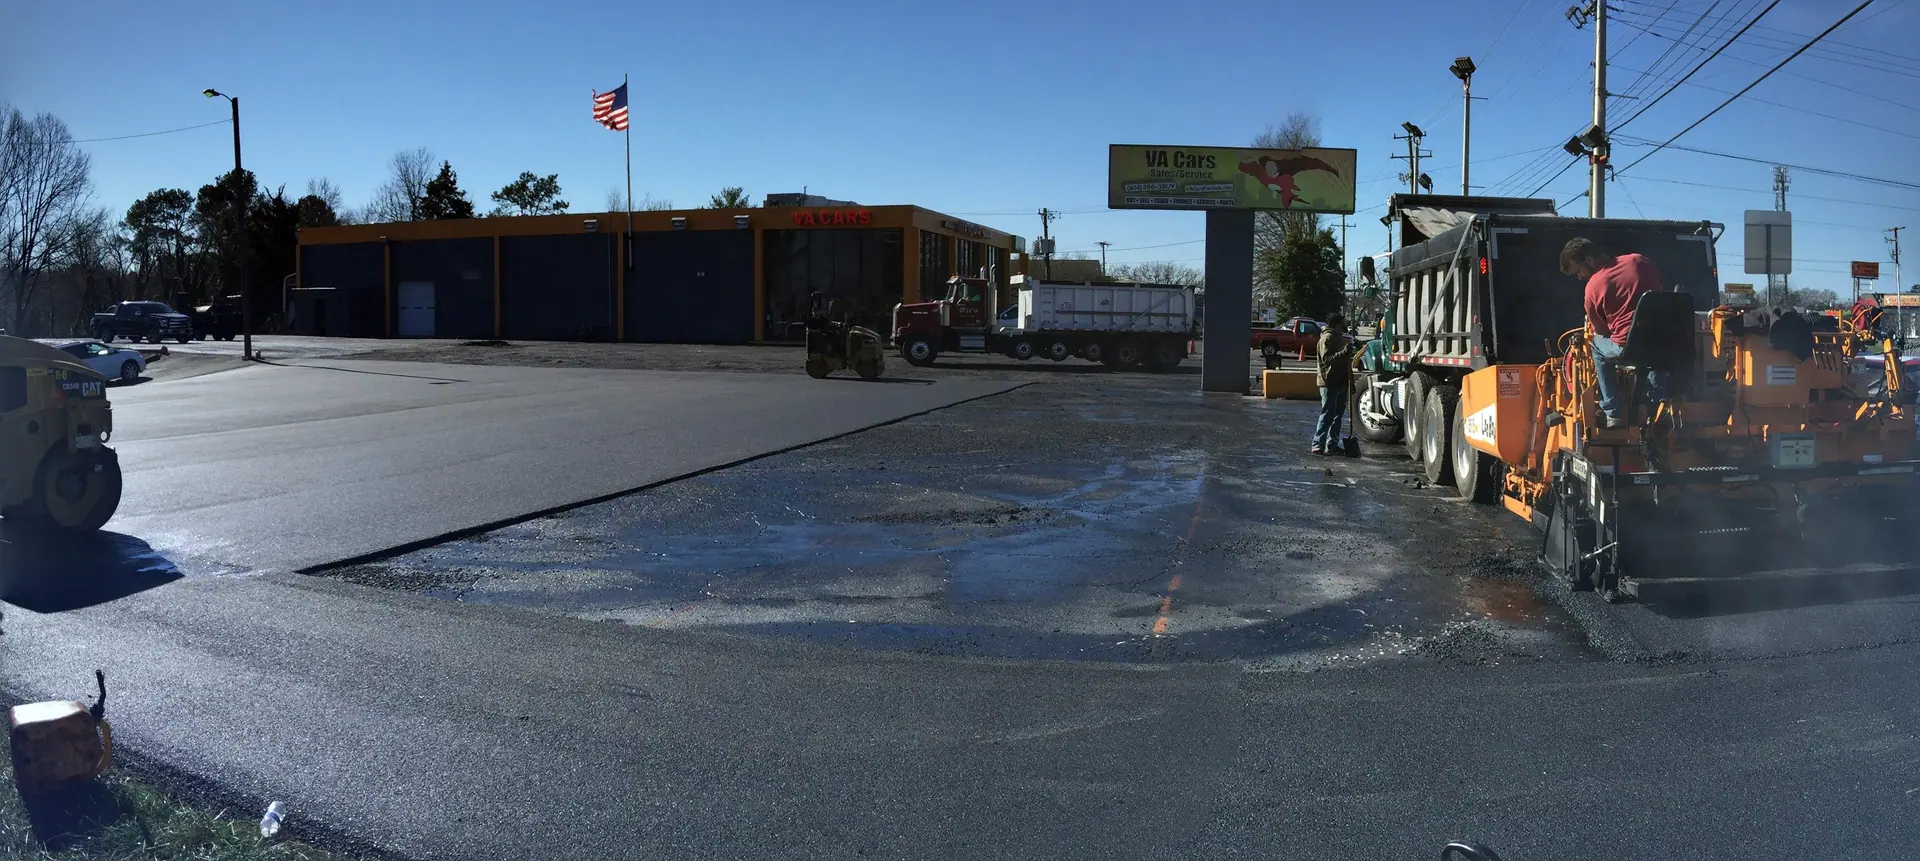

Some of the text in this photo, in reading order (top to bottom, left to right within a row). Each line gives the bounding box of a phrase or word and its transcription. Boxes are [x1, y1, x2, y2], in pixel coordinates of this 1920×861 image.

[1145, 150, 1216, 169] VA Cars
[1150, 168, 1213, 179] Sales/Service
[791, 208, 872, 225] VA CARS
[82, 381, 102, 397] CAT
